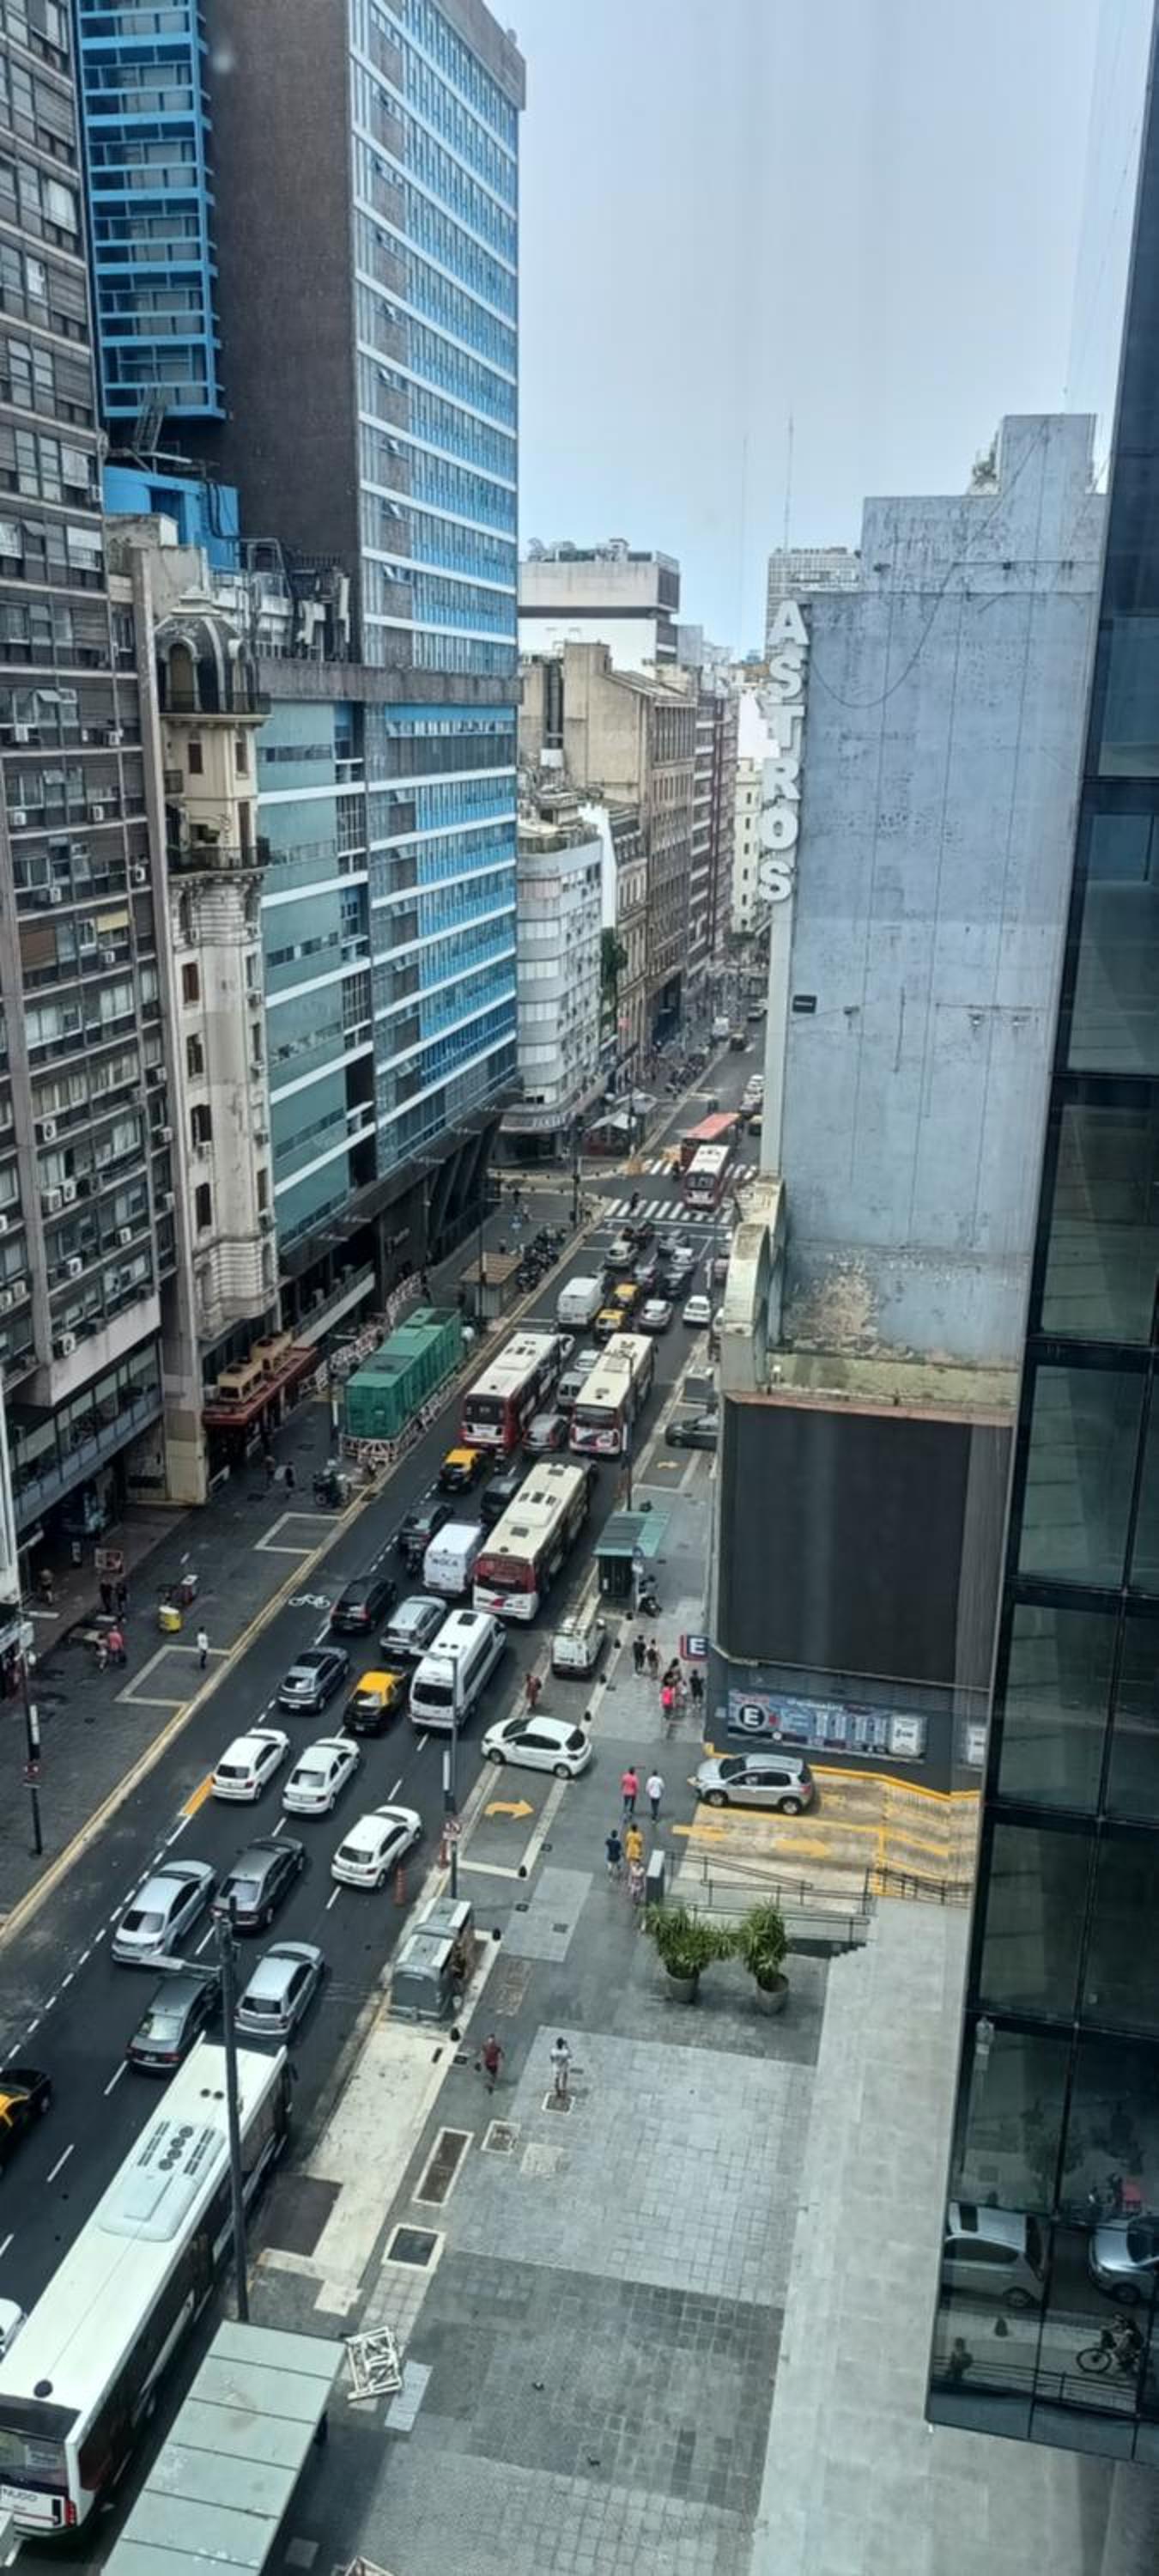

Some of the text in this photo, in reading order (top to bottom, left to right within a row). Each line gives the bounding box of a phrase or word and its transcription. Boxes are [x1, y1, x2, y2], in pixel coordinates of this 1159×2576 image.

[758, 599, 810, 901] ASTROS
[689, 1638, 705, 1655] E
[743, 1708, 759, 1726] E
